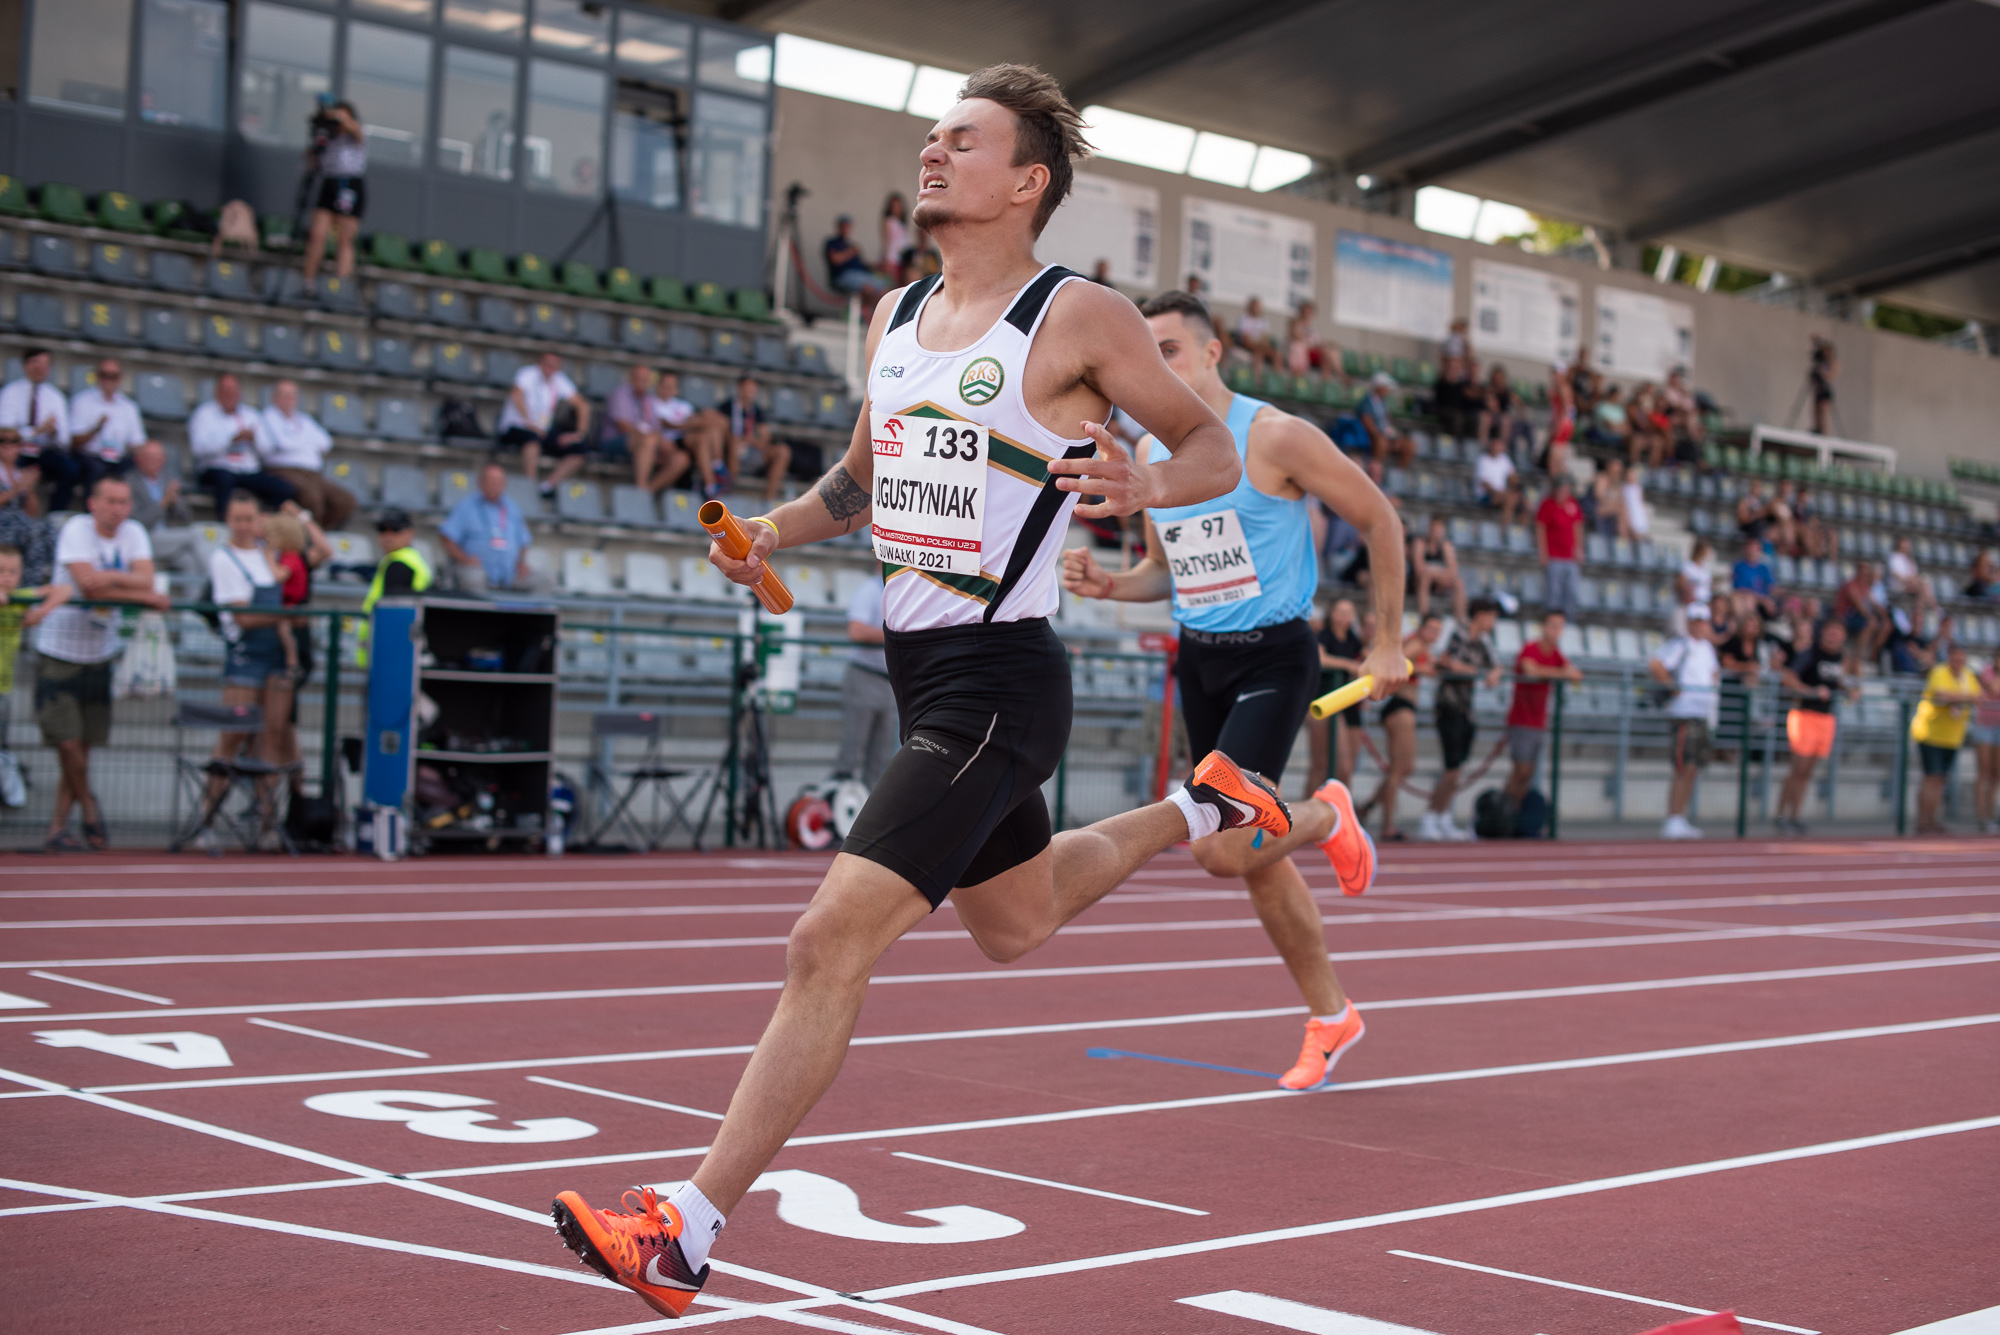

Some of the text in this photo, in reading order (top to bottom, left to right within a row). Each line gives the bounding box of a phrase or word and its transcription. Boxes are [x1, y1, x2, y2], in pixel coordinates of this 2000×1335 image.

[880, 366, 905, 378] esa
[966, 364, 998, 383] RKS
[924, 426, 979, 461] 133
[875, 475, 978, 520] UGUSTYNIAK
[1201, 516, 1223, 538] 97
[926, 538, 956, 547] POLSKI
[957, 541, 976, 550] U23
[918, 552, 952, 569] 2021
[1215, 630, 1264, 644] PRO
[911, 735, 950, 754] BROOKS
[28, 1029, 234, 1069] 4
[303, 1090, 600, 1143] 3
[632, 1168, 1026, 1244] 2
